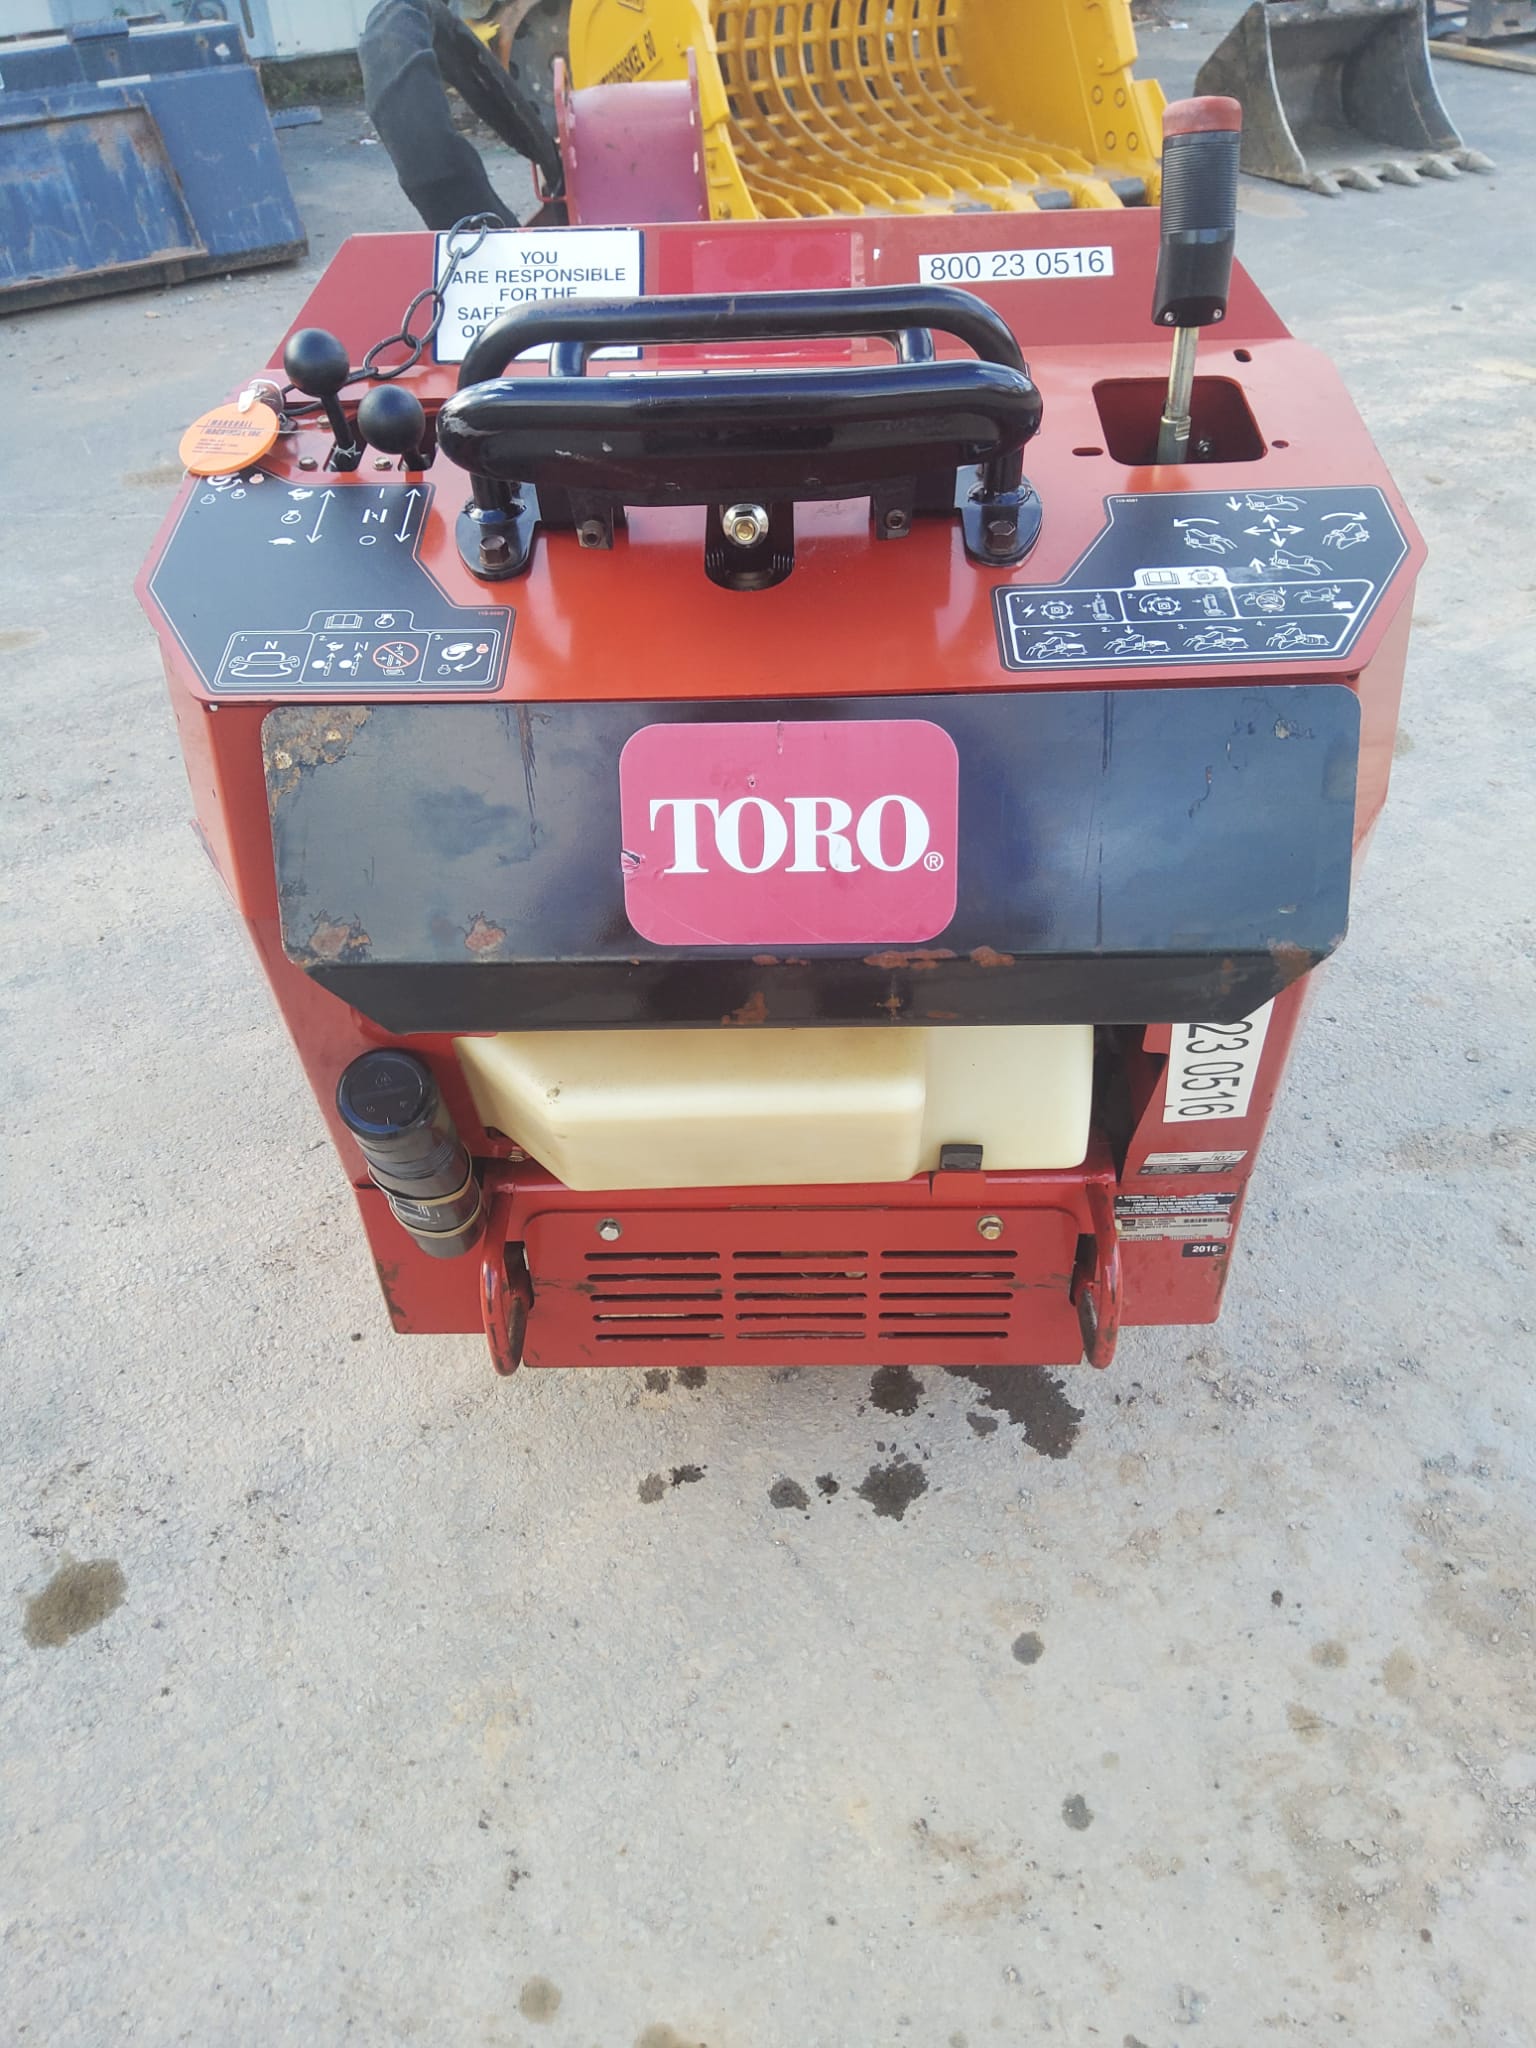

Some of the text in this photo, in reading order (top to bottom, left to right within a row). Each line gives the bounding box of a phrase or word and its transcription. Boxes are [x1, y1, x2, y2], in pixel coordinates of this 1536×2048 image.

[521, 251, 558, 265] YOU
[930, 249, 1105, 280] 800 23 0516
[451, 267, 626, 284] ARE RESPONSIBLE
[499, 286, 578, 301] FOR THE
[264, 640, 279, 650] N
[1186, 1020, 1254, 1054] 23
[1178, 1061, 1244, 1116] 0516
